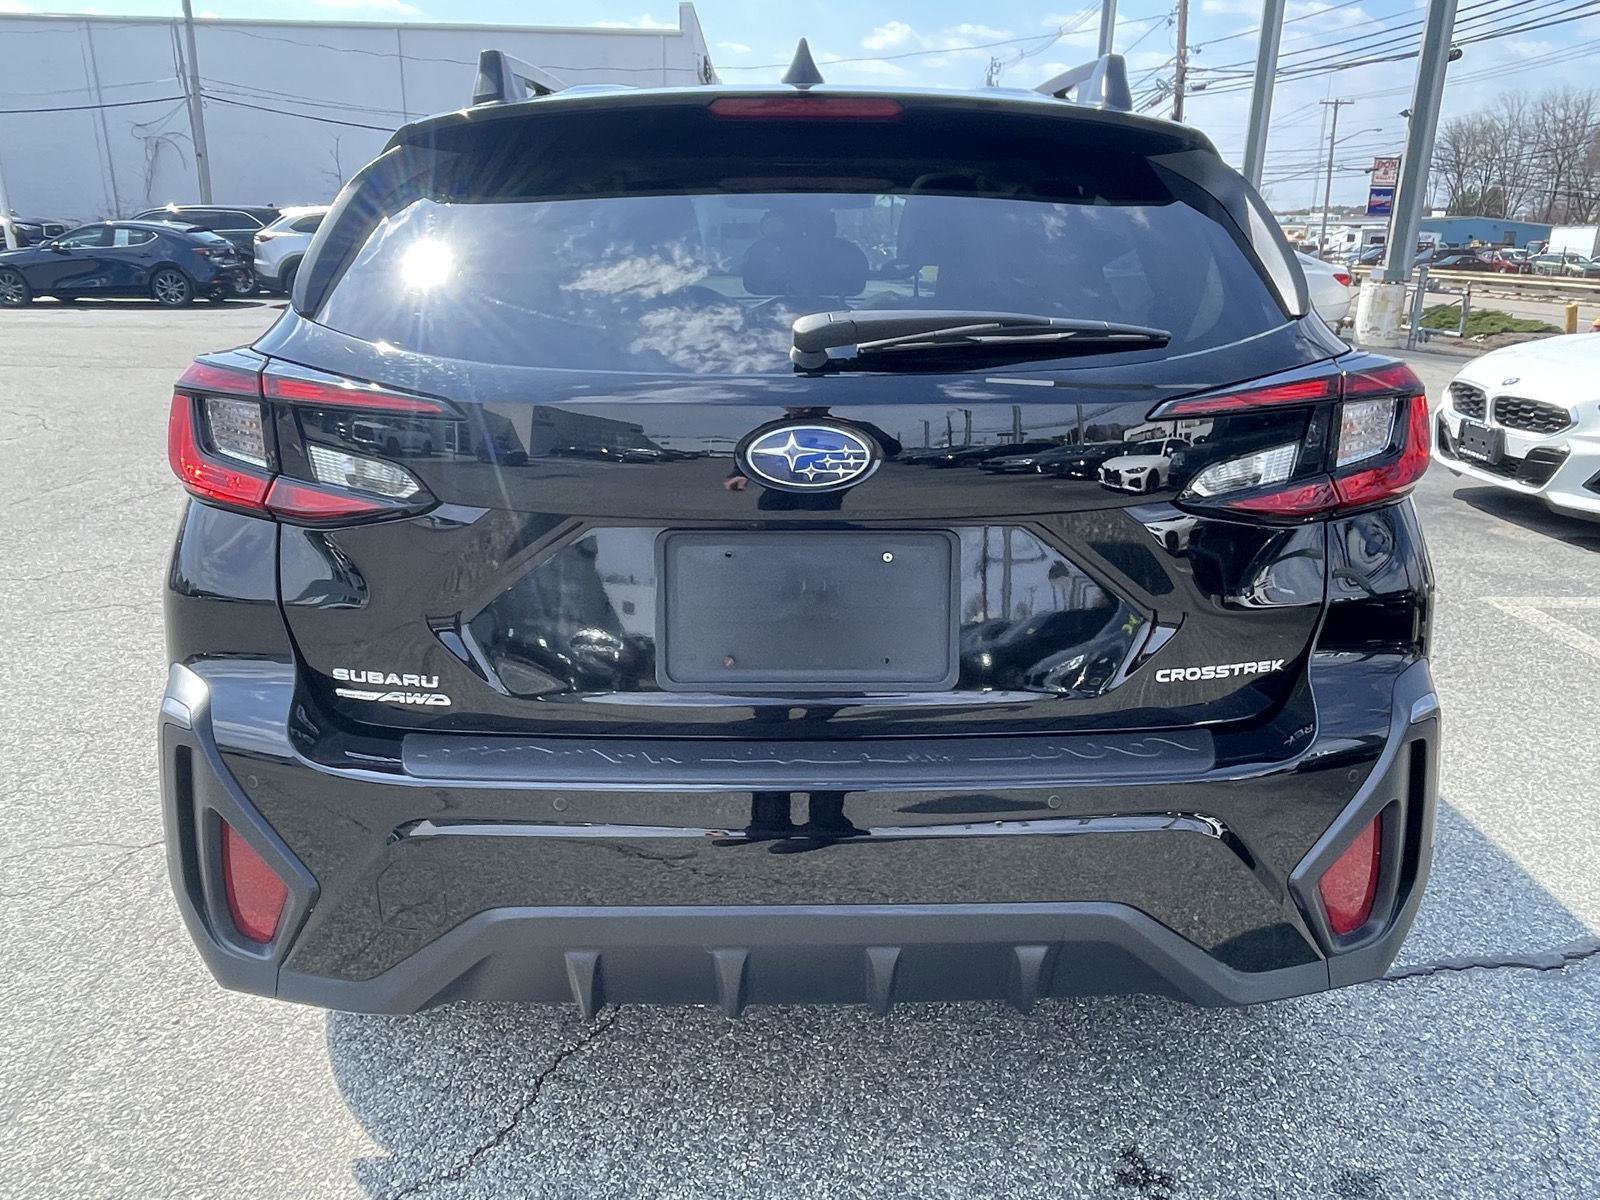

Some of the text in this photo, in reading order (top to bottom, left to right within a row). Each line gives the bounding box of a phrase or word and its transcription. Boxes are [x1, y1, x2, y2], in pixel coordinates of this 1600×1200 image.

[332, 668, 439, 688] SUBARU
[1155, 659, 1285, 682] CROSSTREK
[378, 691, 452, 706] AWD
